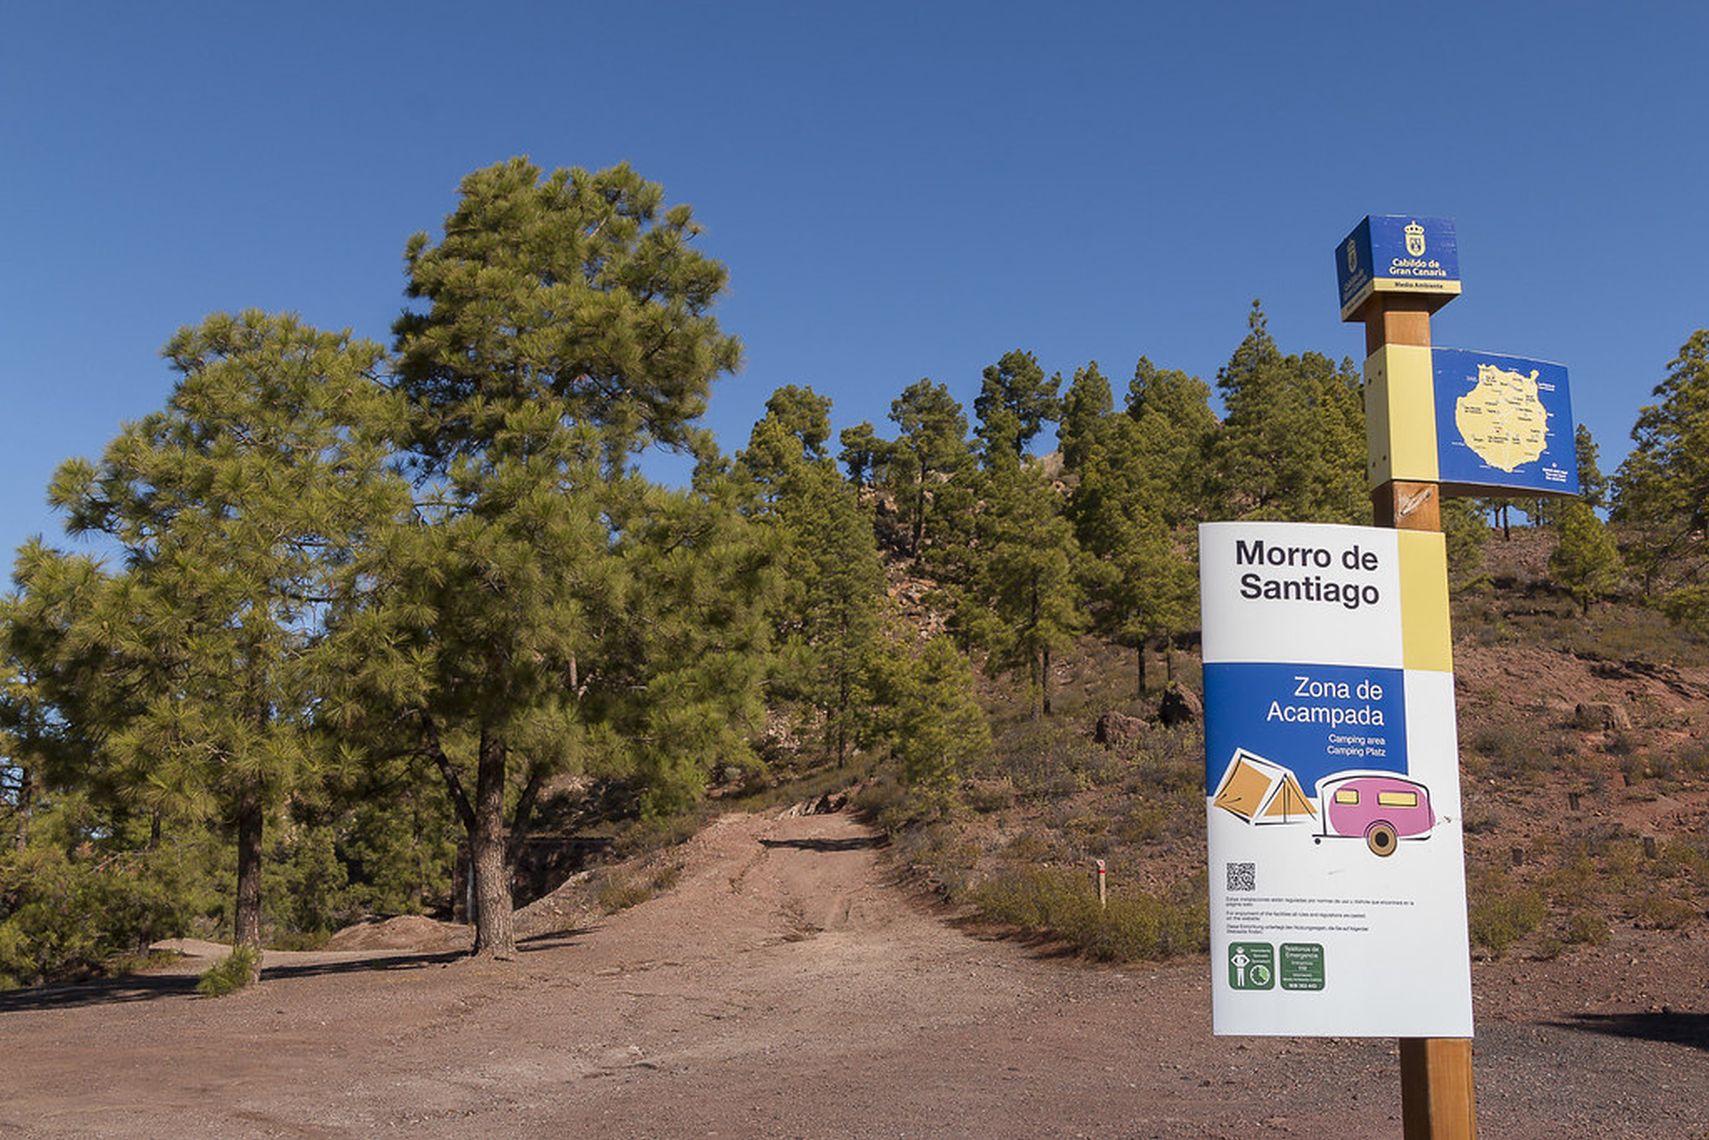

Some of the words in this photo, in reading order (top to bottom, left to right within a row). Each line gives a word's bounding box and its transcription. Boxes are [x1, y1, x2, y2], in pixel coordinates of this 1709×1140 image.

[1389, 266, 1411, 275] Gran
[1412, 267, 1447, 277] Canaria
[1392, 258, 1427, 268] Cabildo
[1428, 260, 1440, 268] de
[1235, 540, 1331, 568] Morro
[1341, 545, 1379, 571] de
[1240, 573, 1379, 610] Santiago
[1294, 676, 1350, 699] Zona
[1356, 679, 1383, 700] de
[1266, 700, 1384, 728] Acampada
[1328, 733, 1366, 746] Camping
[1366, 736, 1386, 745] area
[1327, 745, 1365, 757] Camping
[1365, 747, 1386, 757] Platz
